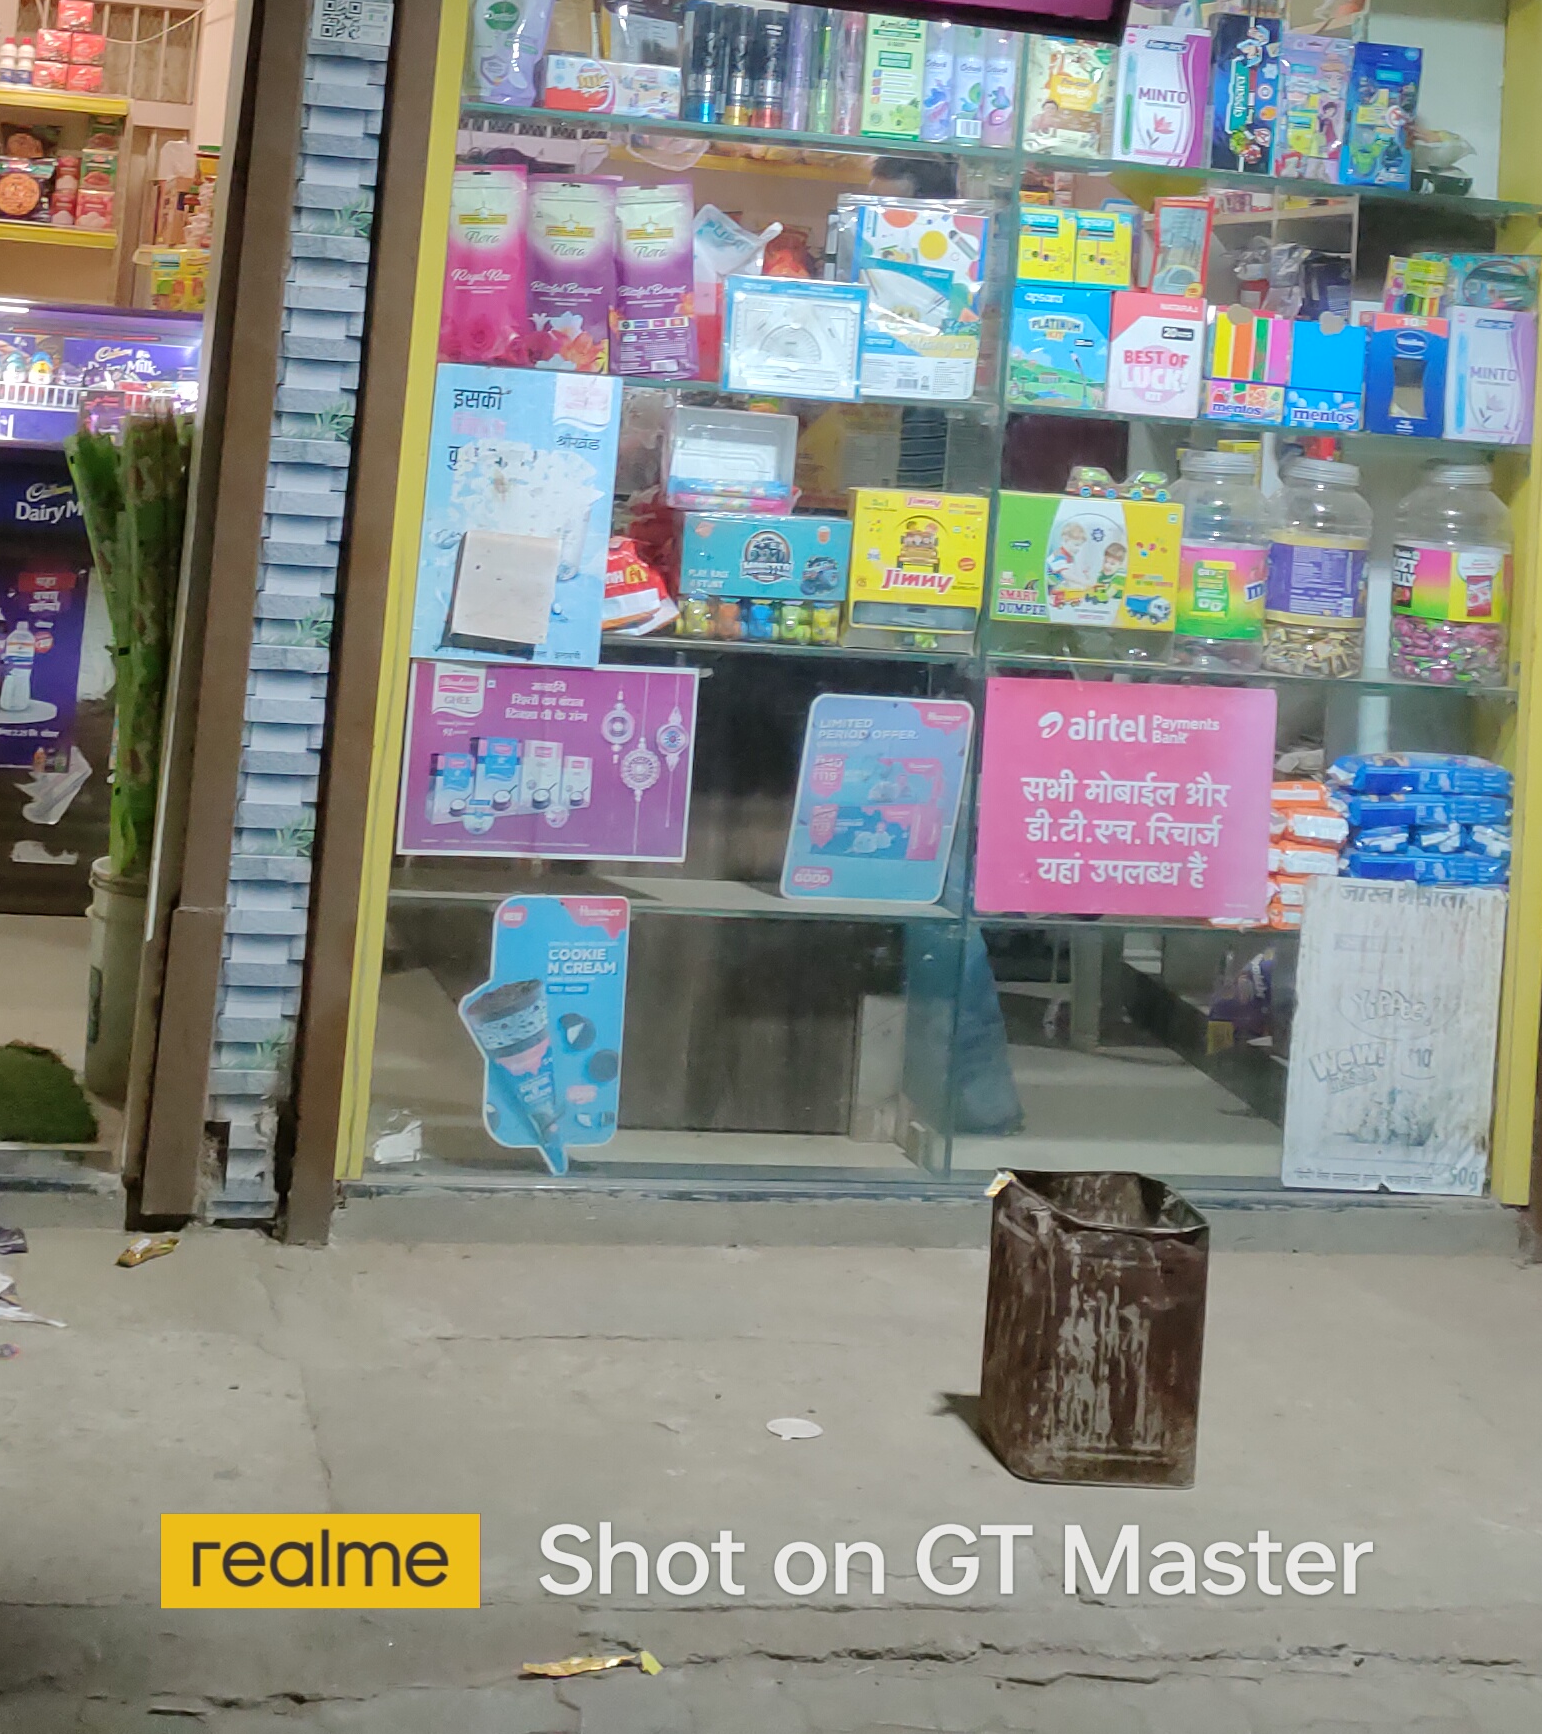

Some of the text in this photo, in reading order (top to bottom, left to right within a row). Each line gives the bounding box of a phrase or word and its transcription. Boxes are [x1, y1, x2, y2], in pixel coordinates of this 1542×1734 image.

[1138, 86, 1189, 105] MINTO
[1024, 292, 1065, 305] apsara
[1031, 317, 1082, 333] PLATINUM
[1123, 349, 1190, 367] BEST OF
[1119, 366, 1188, 393] LUCK!
[1470, 365, 1517, 382] MINTO
[452, 385, 503, 411] इसकी
[1212, 402, 1262, 416] mentos
[1292, 407, 1355, 425] mentos
[15, 502, 66, 524] Dairy
[998, 588, 1040, 602] SMART
[997, 602, 1048, 617] DUMPER
[444, 695, 473, 705] GHEE
[819, 718, 874, 729] LIMITED
[1068, 710, 1147, 743] airtel
[1151, 715, 1221, 732] Payments
[818, 729, 869, 740] PERIOD
[1151, 730, 1189, 744] Bank
[1020, 768, 1232, 808] सभी मोबाईल और
[1146, 811, 1223, 848] रिचार्ज
[1036, 850, 1209, 889] यहां उपलब्ध हैं
[548, 948, 607, 961] COOKIE
[562, 962, 617, 976] CREAM
